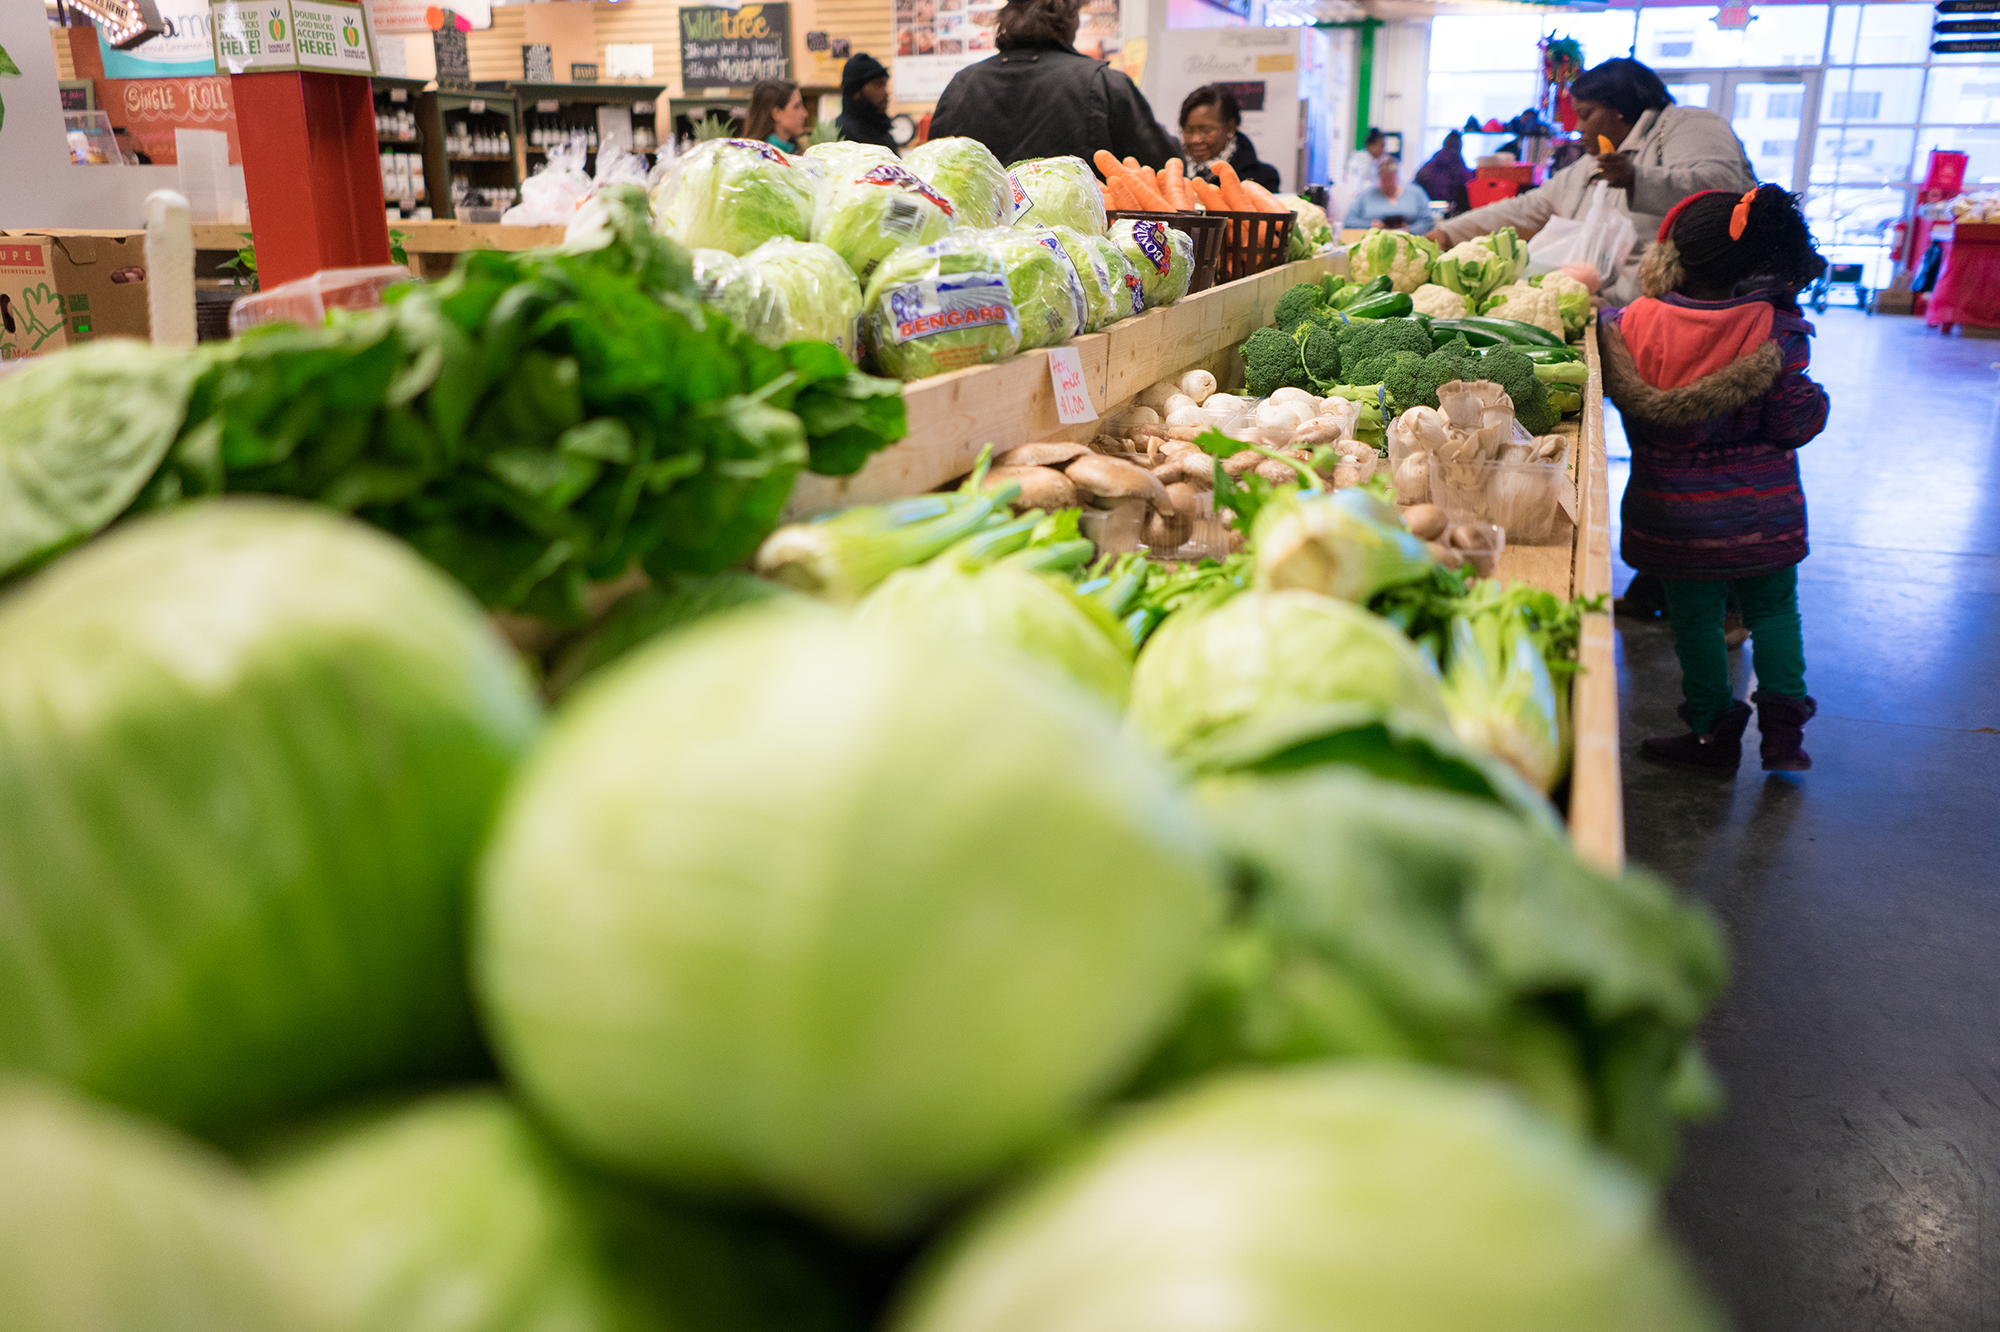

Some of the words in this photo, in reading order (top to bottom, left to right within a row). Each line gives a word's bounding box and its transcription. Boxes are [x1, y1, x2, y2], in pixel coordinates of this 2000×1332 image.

[217, 11, 247, 21] DLE
[248, 11, 258, 20] UP
[294, 10, 321, 21] DOUBLE
[322, 13, 332, 22] UP
[243, 20, 260, 29] UCKS
[314, 22, 334, 31] BUCKS
[297, 29, 336, 41] ACCEPTED
[298, 39, 338, 57] HERE!
[188, 82, 229, 111] ROLL
[900, 306, 1006, 338] BENGARD
[1060, 395, 1085, 419] $1.00
